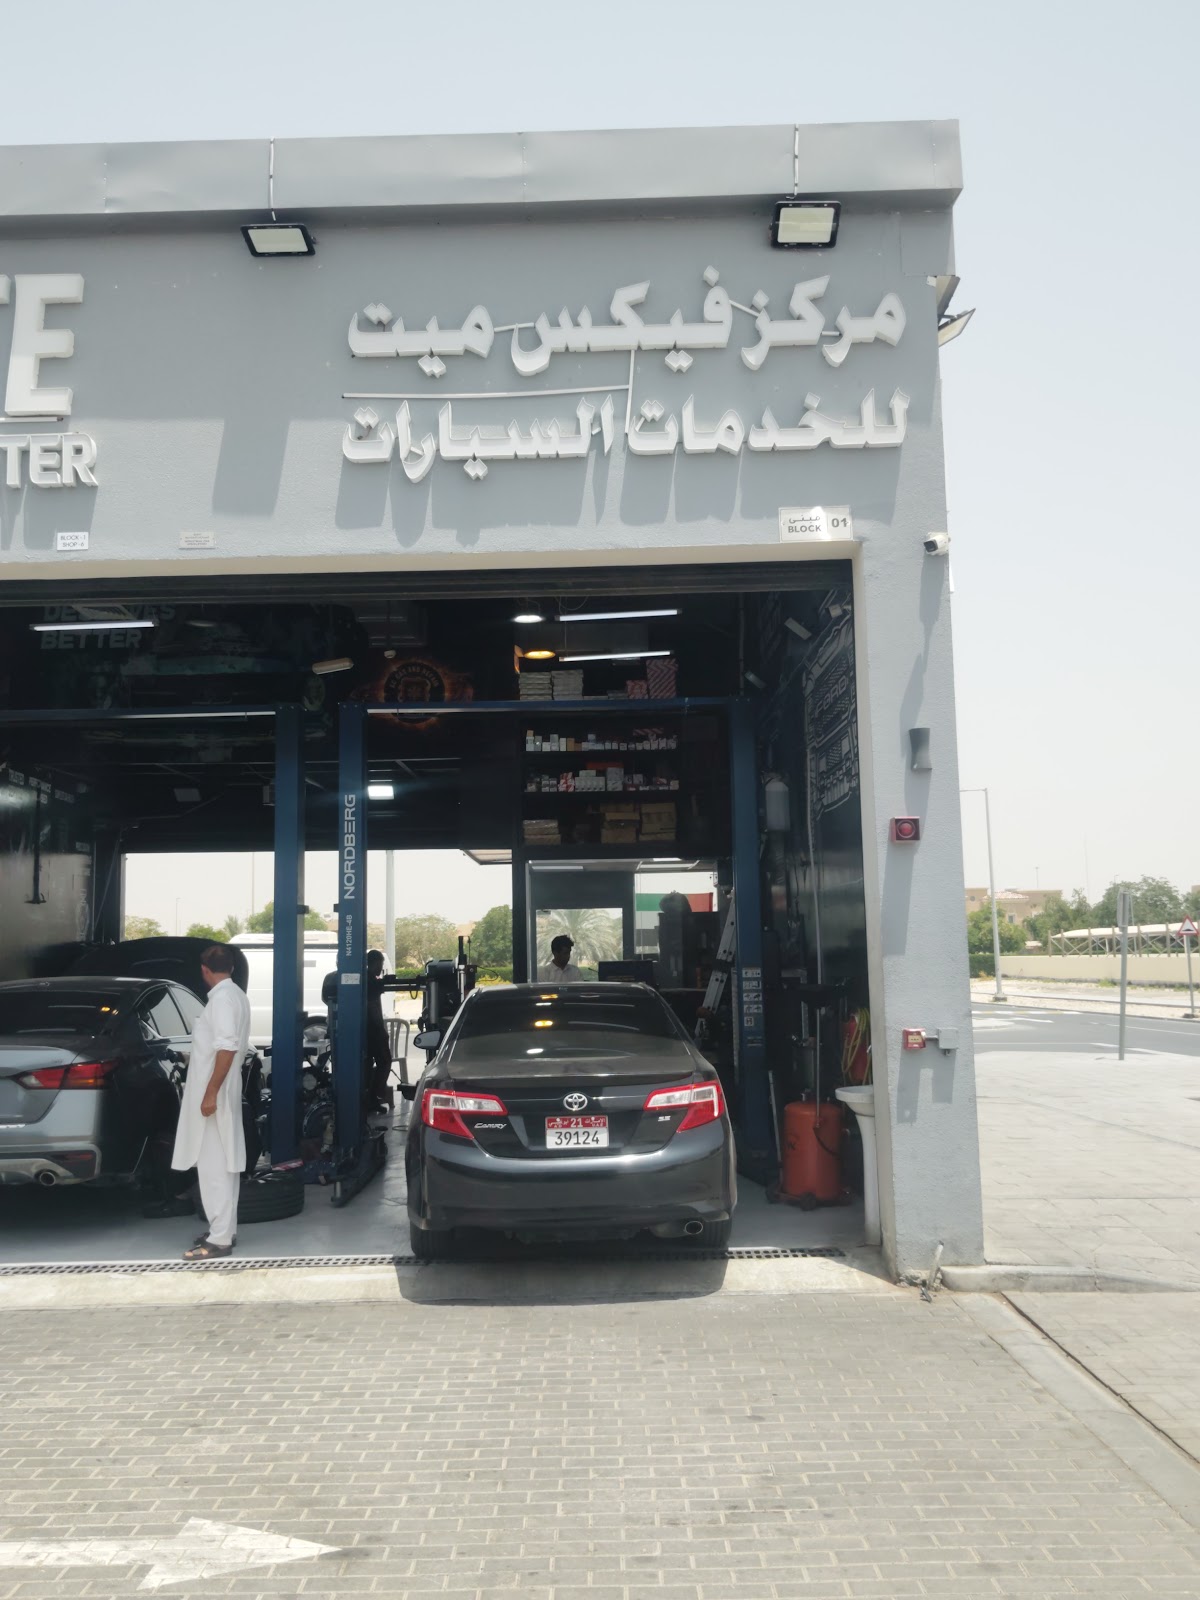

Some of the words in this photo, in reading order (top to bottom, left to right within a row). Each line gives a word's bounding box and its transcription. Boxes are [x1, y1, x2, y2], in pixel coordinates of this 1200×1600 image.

[347, 302, 496, 378] ميت
[510, 265, 735, 377] فيكس
[741, 274, 907, 371] مركز
[341, 392, 615, 484] السيارات
[627, 387, 911, 457] للخدمات
[788, 524, 822, 534] BLOCK
[831, 517, 848, 529] 01
[43, 604, 176, 622] DEVES
[40, 629, 143, 650] BETTER
[343, 794, 357, 900] NORDBERG
[554, 1130, 600, 1146] 39124
[570, 1117, 584, 1128] 21
